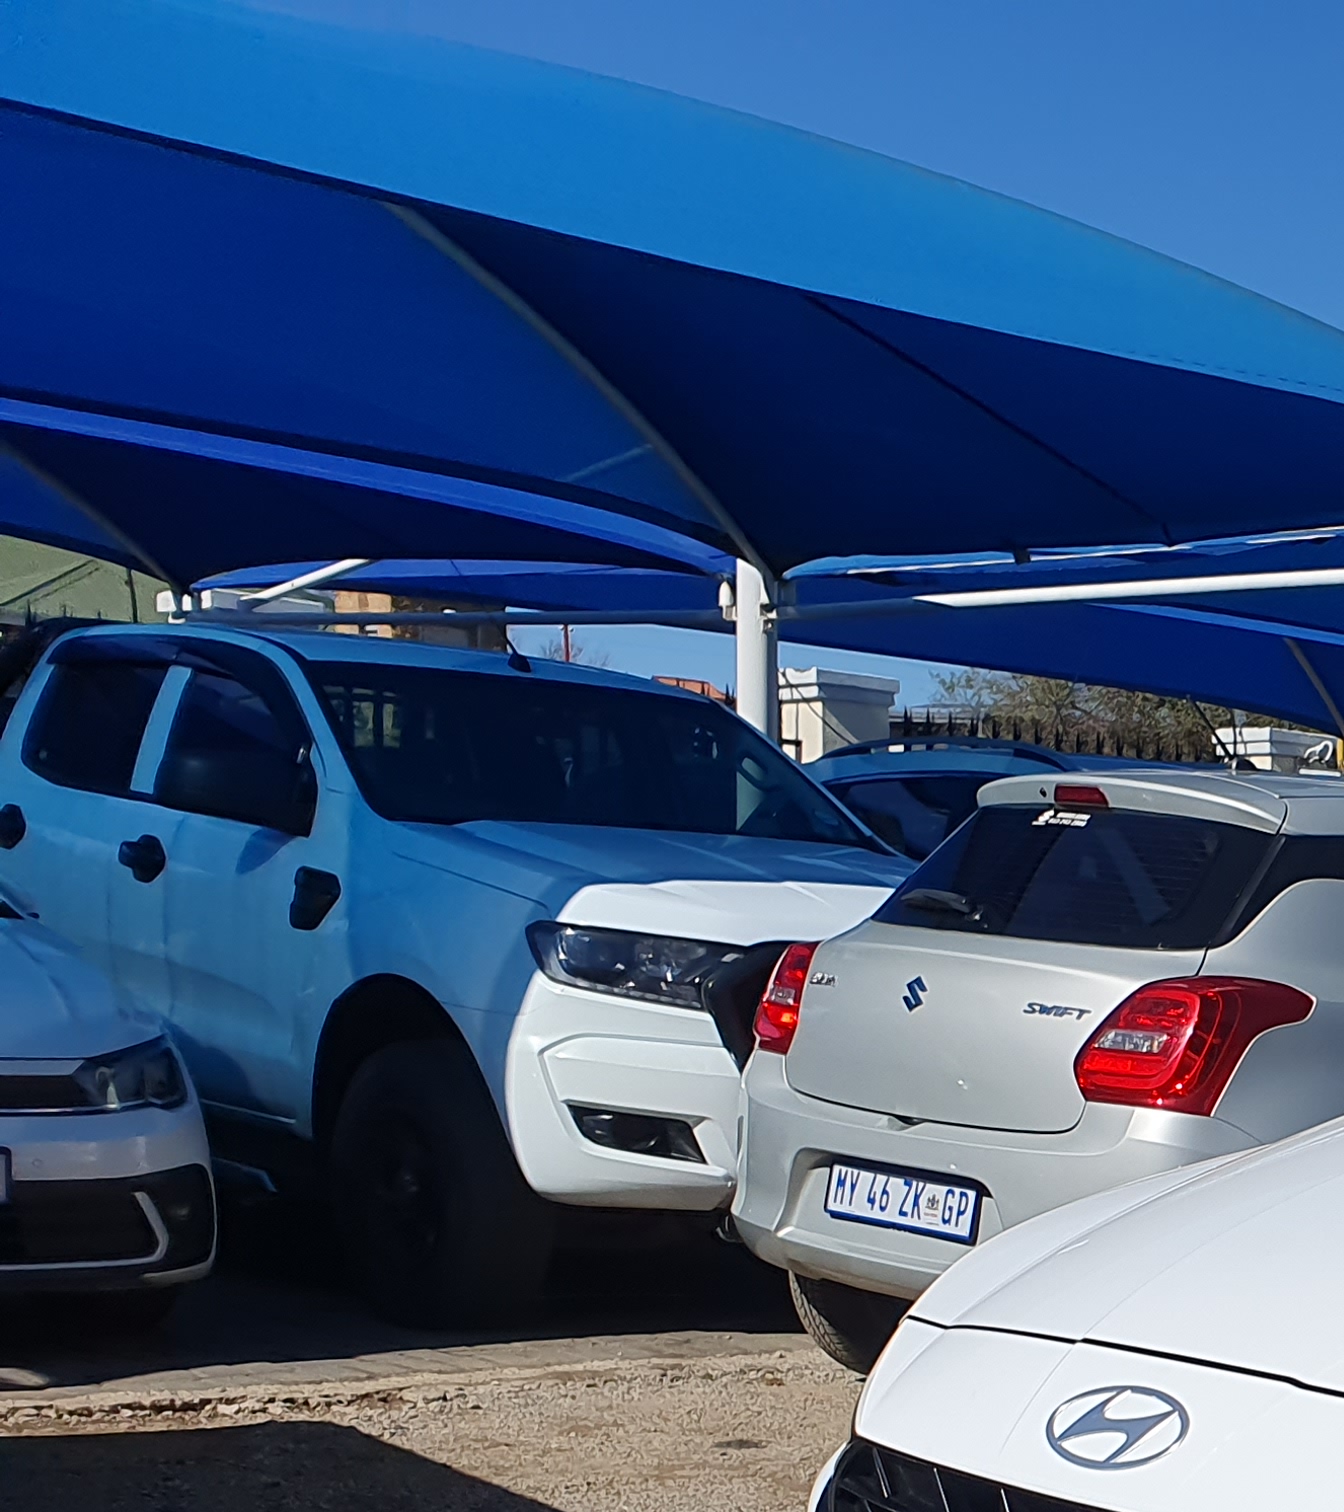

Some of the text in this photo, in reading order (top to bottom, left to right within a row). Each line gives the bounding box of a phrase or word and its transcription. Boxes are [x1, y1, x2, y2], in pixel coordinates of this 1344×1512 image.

[1023, 1002, 1092, 1020] SWIFT
[833, 1168, 969, 1227] MY 46 ZK GP
